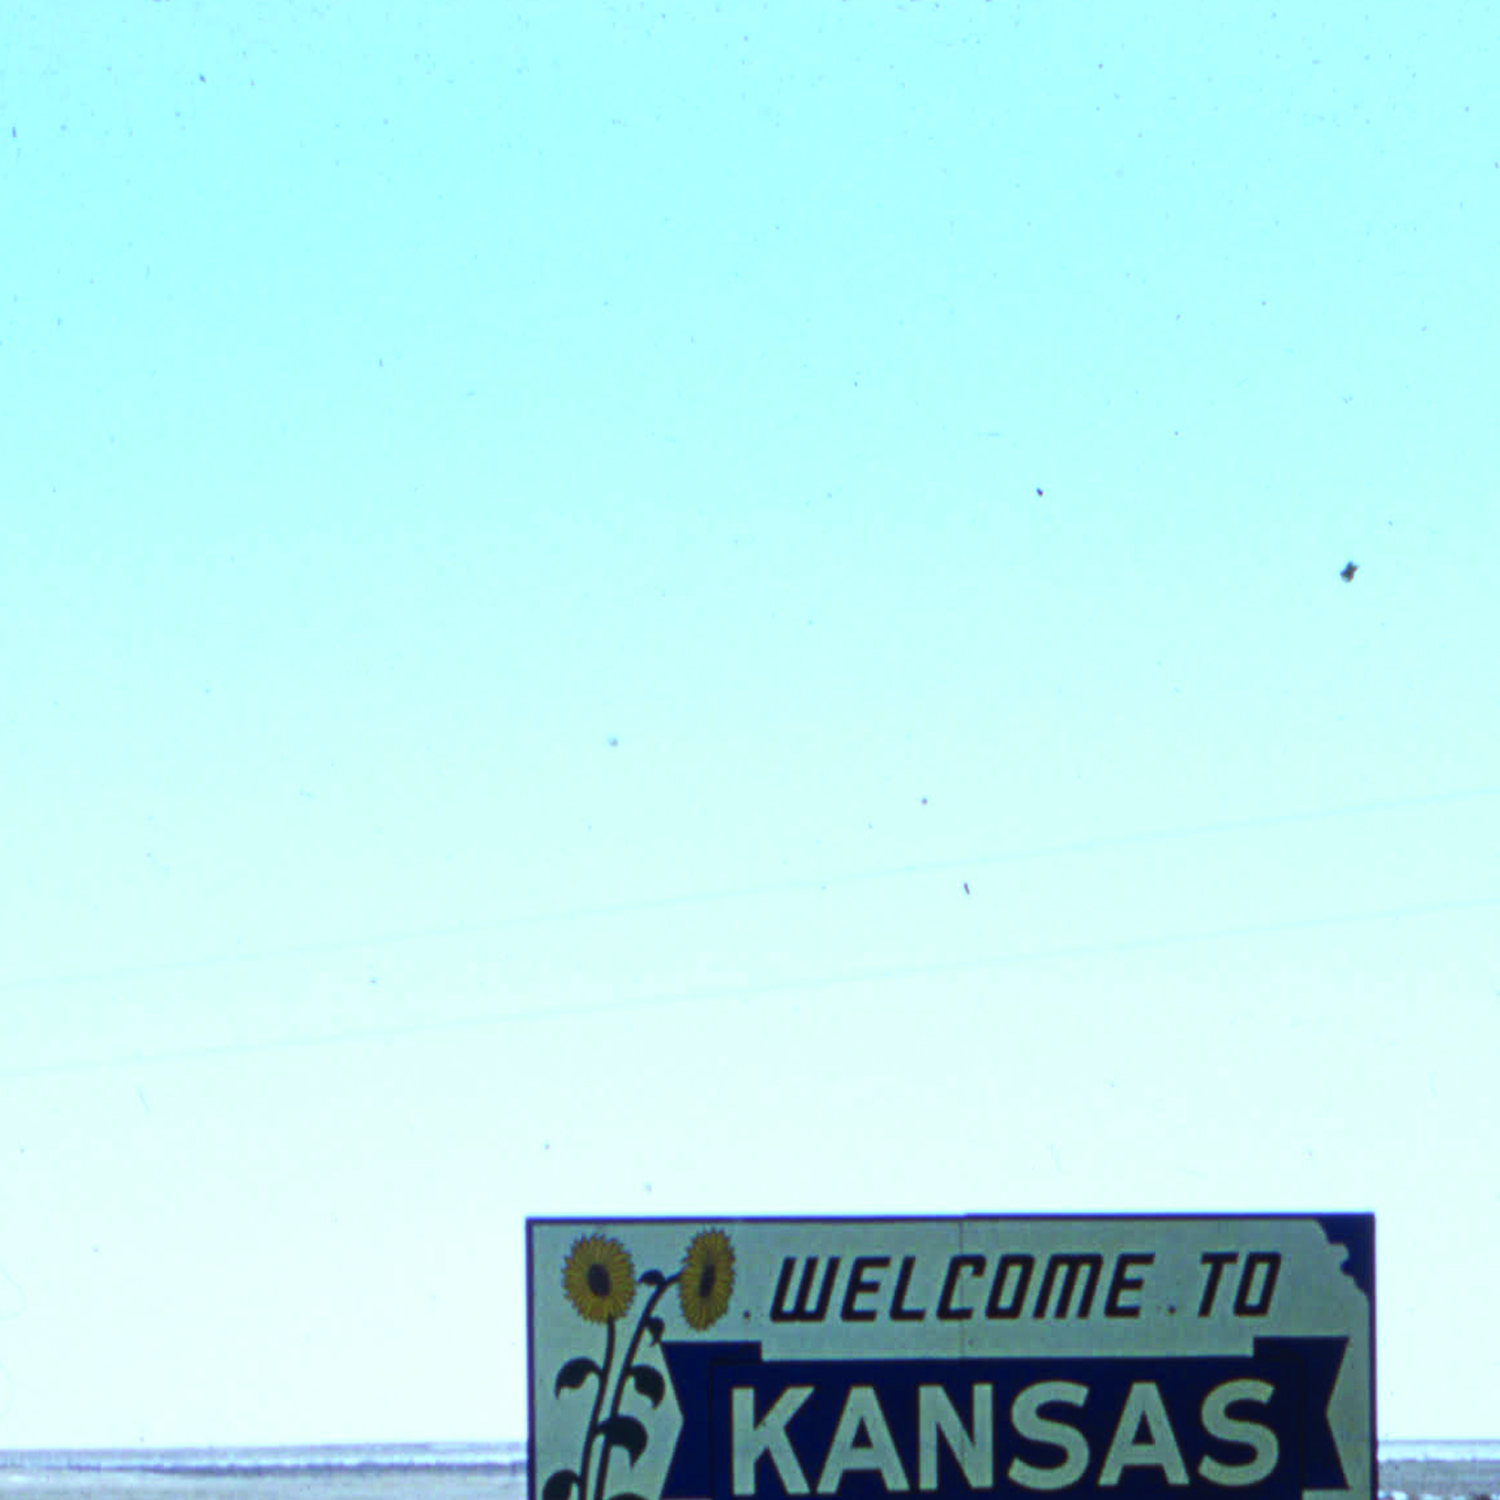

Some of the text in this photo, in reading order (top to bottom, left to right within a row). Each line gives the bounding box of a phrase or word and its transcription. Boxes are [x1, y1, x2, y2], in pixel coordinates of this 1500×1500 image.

[771, 1250, 1281, 1322] WELCOME TO
[730, 1378, 1282, 1497] KANSAS
